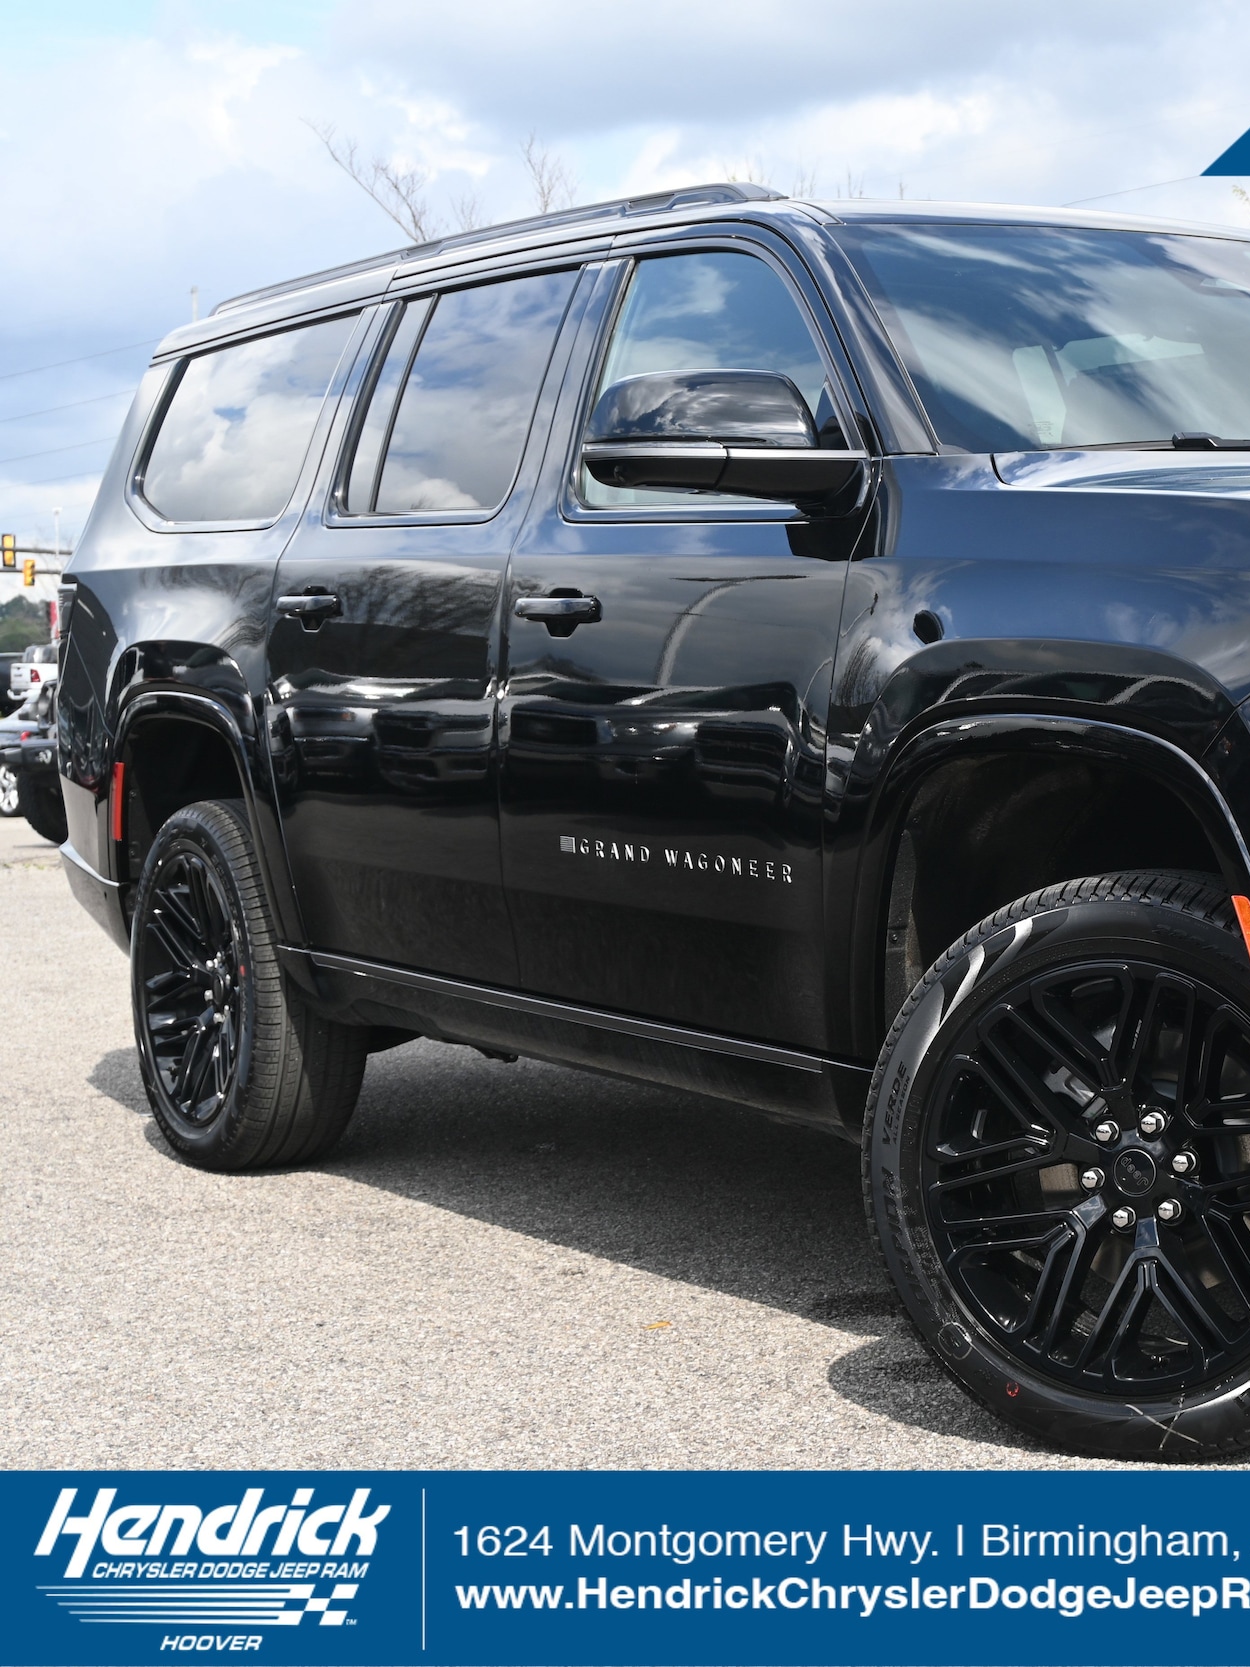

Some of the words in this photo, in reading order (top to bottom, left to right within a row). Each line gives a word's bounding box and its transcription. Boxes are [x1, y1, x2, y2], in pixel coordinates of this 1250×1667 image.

[580, 838, 651, 863] GRAND
[664, 849, 793, 884] WAGONEER
[881, 1060, 908, 1146] VERDE
[1120, 1156, 1150, 1186] Jeep
